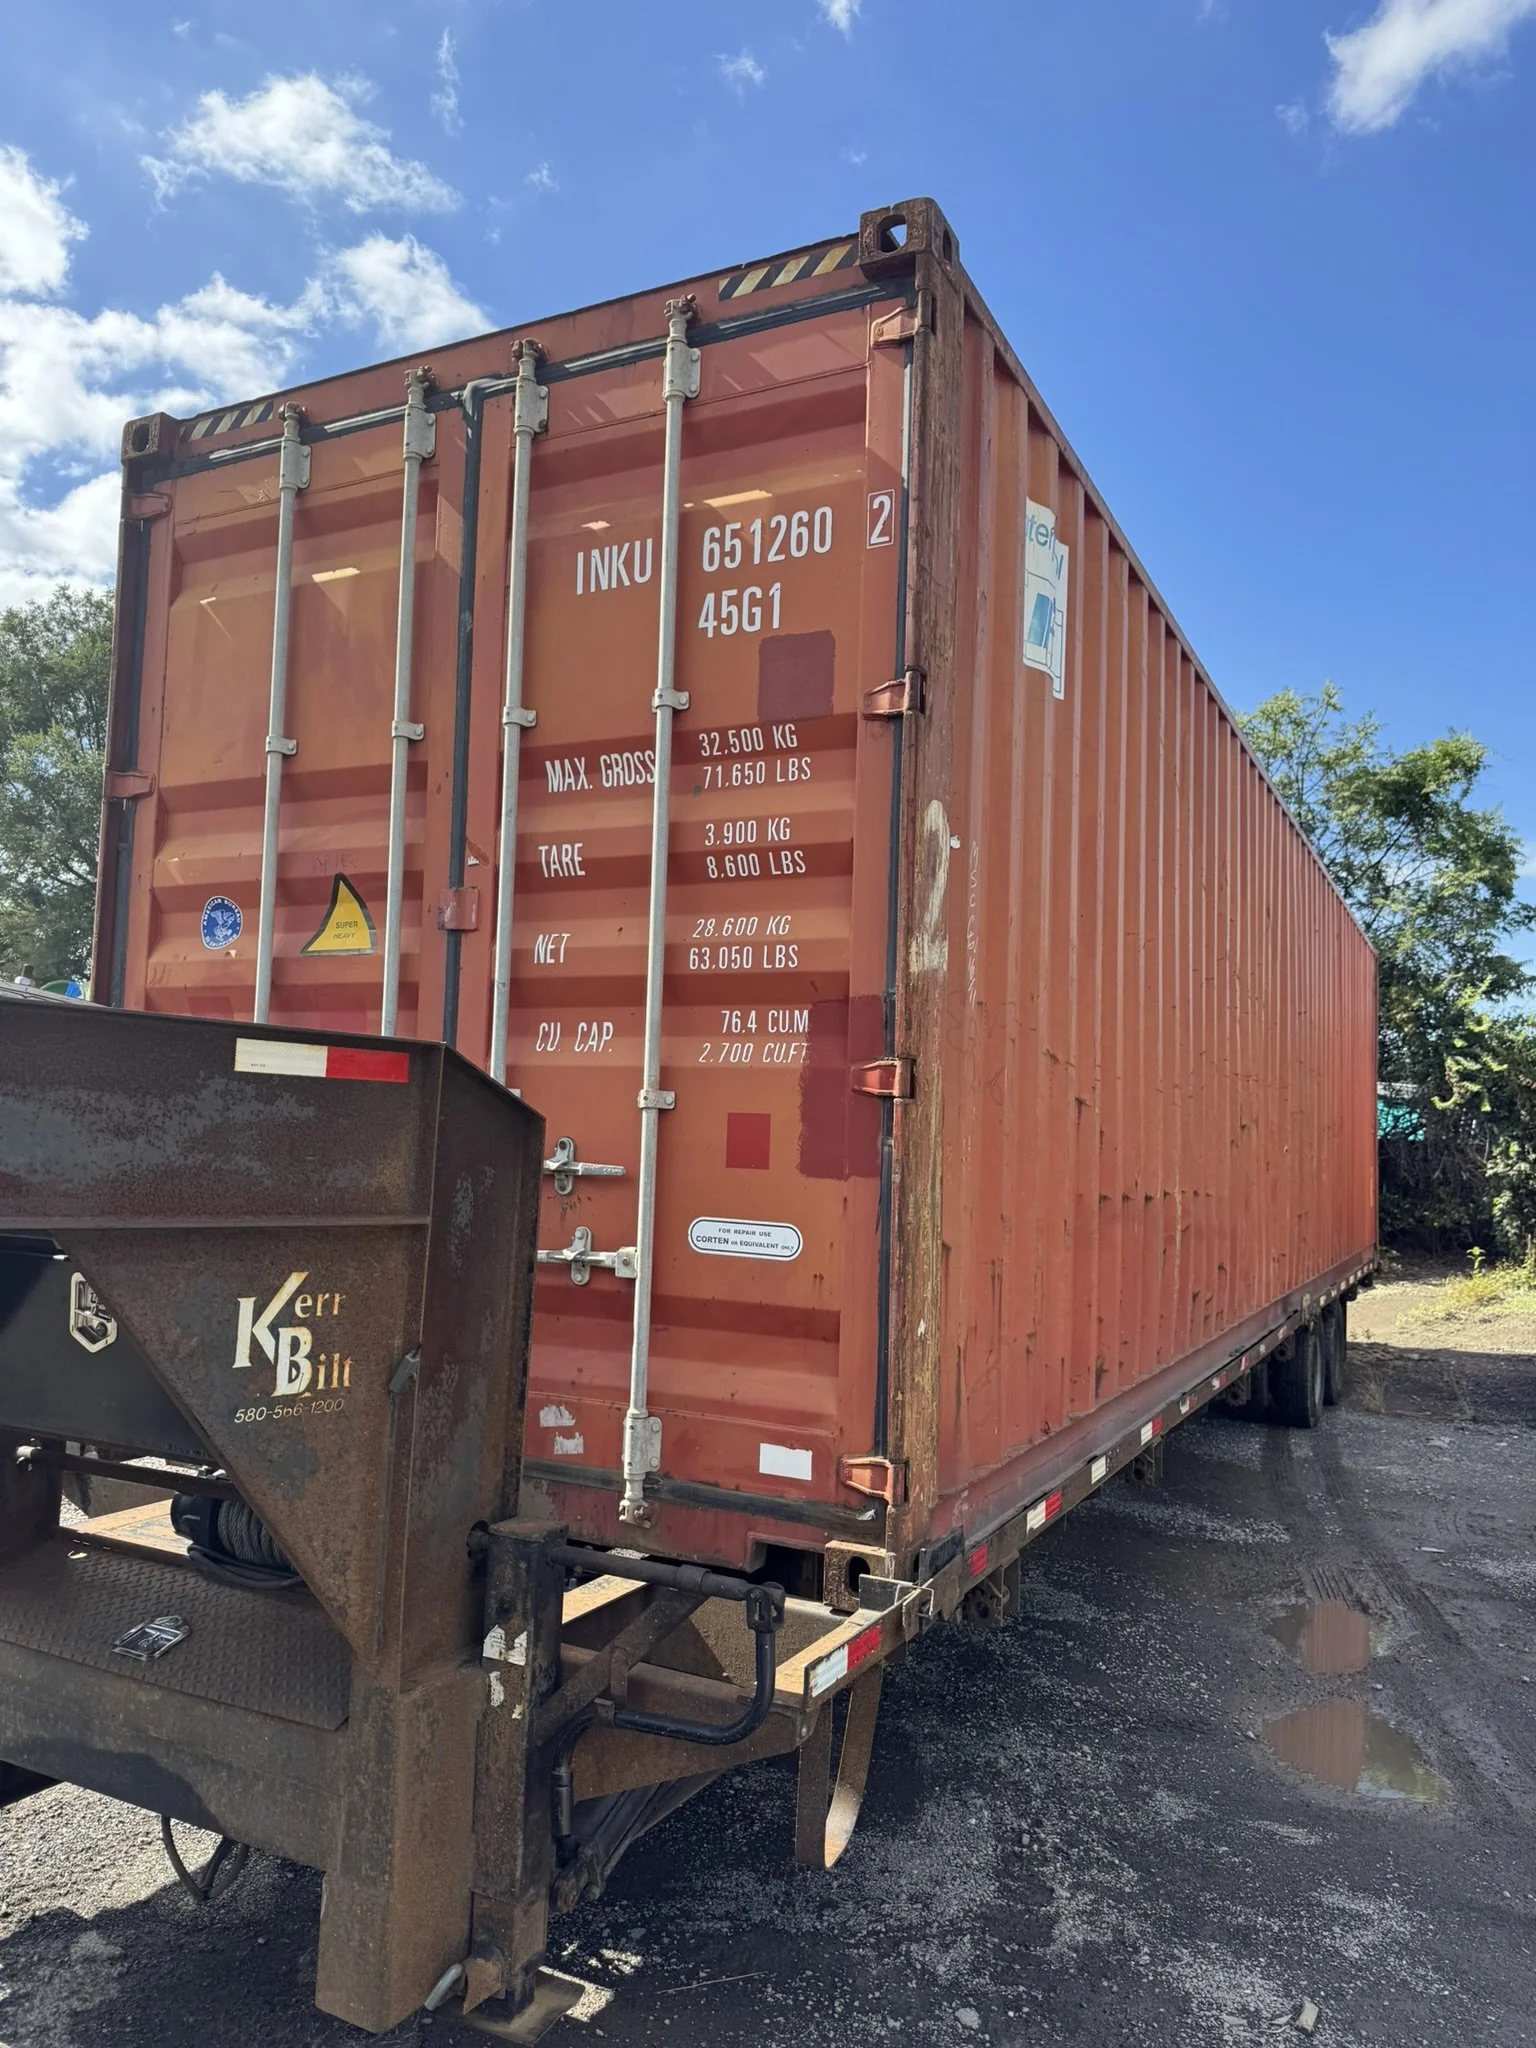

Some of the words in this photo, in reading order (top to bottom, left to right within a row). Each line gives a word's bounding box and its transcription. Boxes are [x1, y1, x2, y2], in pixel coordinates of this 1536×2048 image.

[576, 538, 654, 596] INKU
[702, 506, 833, 573] 651260
[869, 494, 892, 545] 2
[698, 582, 782, 639] 45G1
[545, 757, 593, 793] MAX.
[600, 750, 656, 788] GROSS
[772, 724, 798, 750] KG
[776, 757, 811, 782] LBS
[538, 843, 586, 878] TARE
[767, 817, 791, 842] KG
[768, 850, 806, 875] LBS
[336, 921, 358, 929] SUPER
[534, 933, 571, 964] NET
[766, 915, 791, 935] KG
[763, 944, 798, 969] LBS
[574, 1021, 613, 1052] CAP.
[721, 1010, 757, 1033] 76.4
[768, 1010, 809, 1033] CU.M
[695, 1235, 729, 1245] CORTEN
[739, 1240, 779, 1249] EQUIVALENT
[232, 1271, 346, 1368] Kerr
[270, 1326, 352, 1399] Bilt
